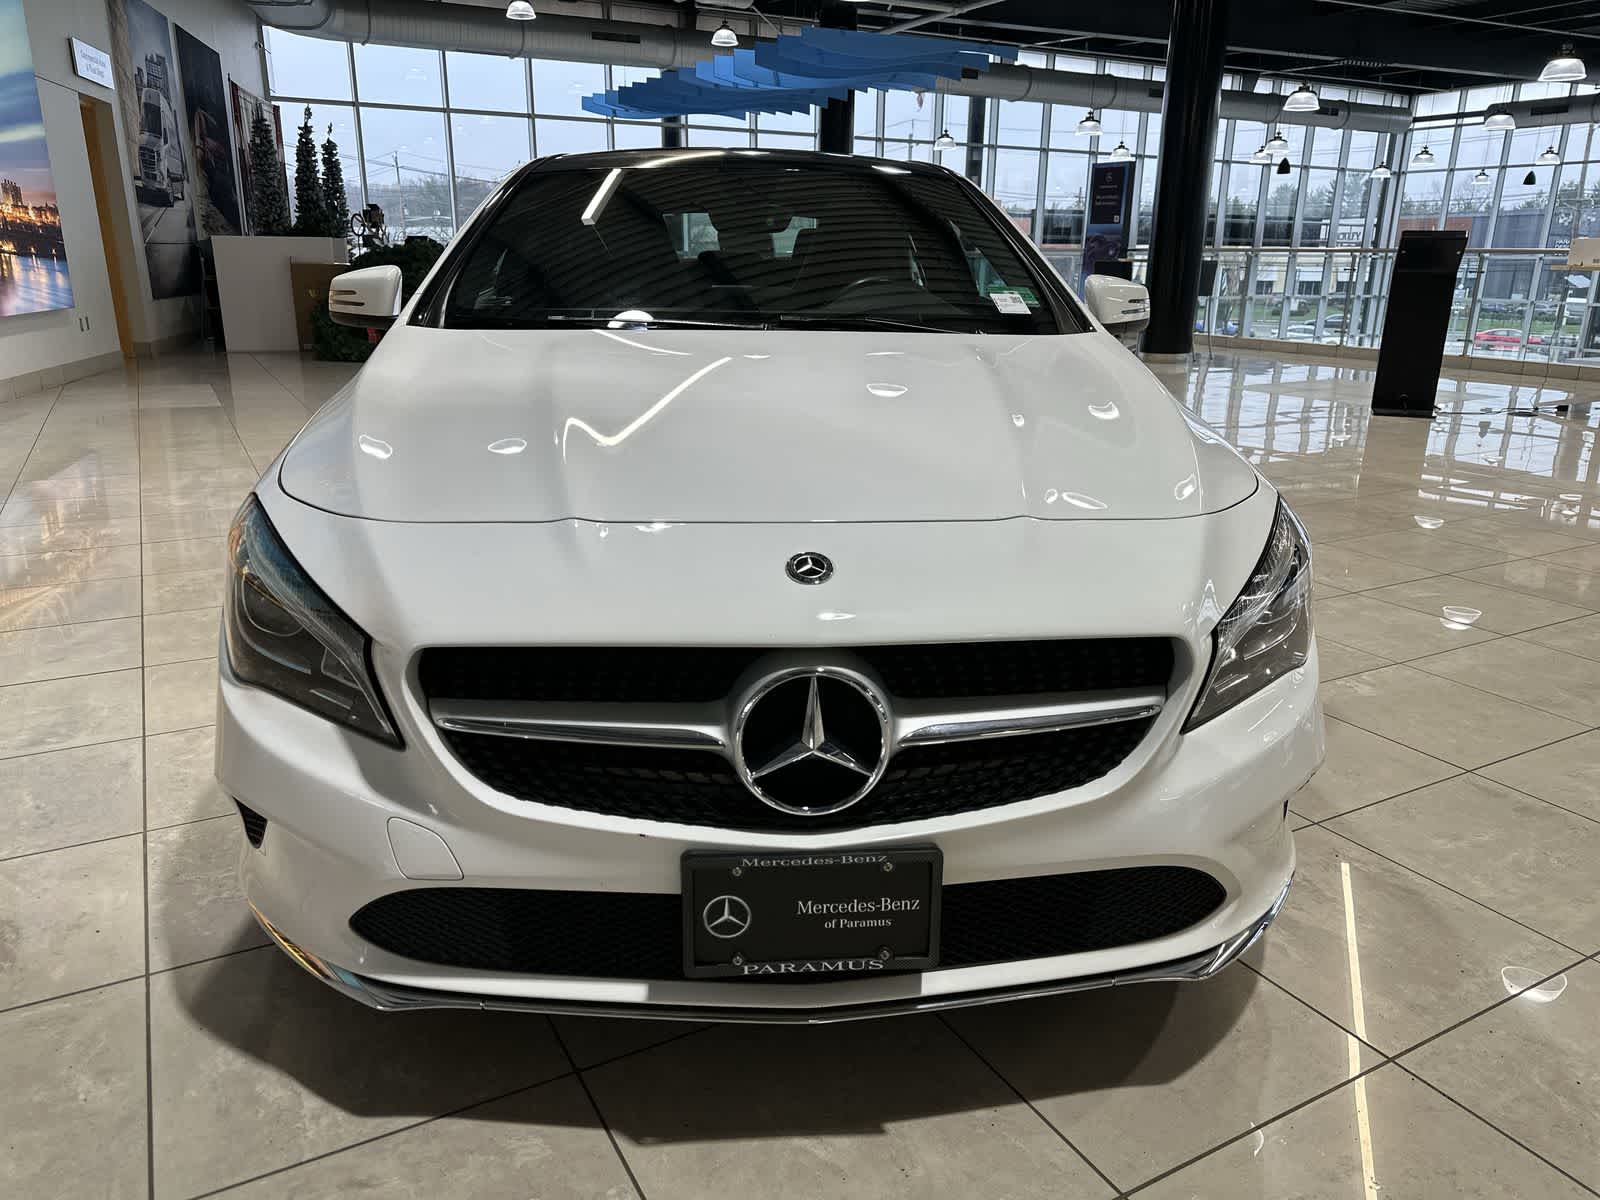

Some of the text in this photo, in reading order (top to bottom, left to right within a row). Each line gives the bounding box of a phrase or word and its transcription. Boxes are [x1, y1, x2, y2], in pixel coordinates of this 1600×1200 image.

[742, 855, 888, 867] Mercedes-Benz
[797, 897, 920, 915] Mercedes-Benz
[824, 918, 892, 929] of Paramus
[742, 959, 884, 975] PARAMUS
